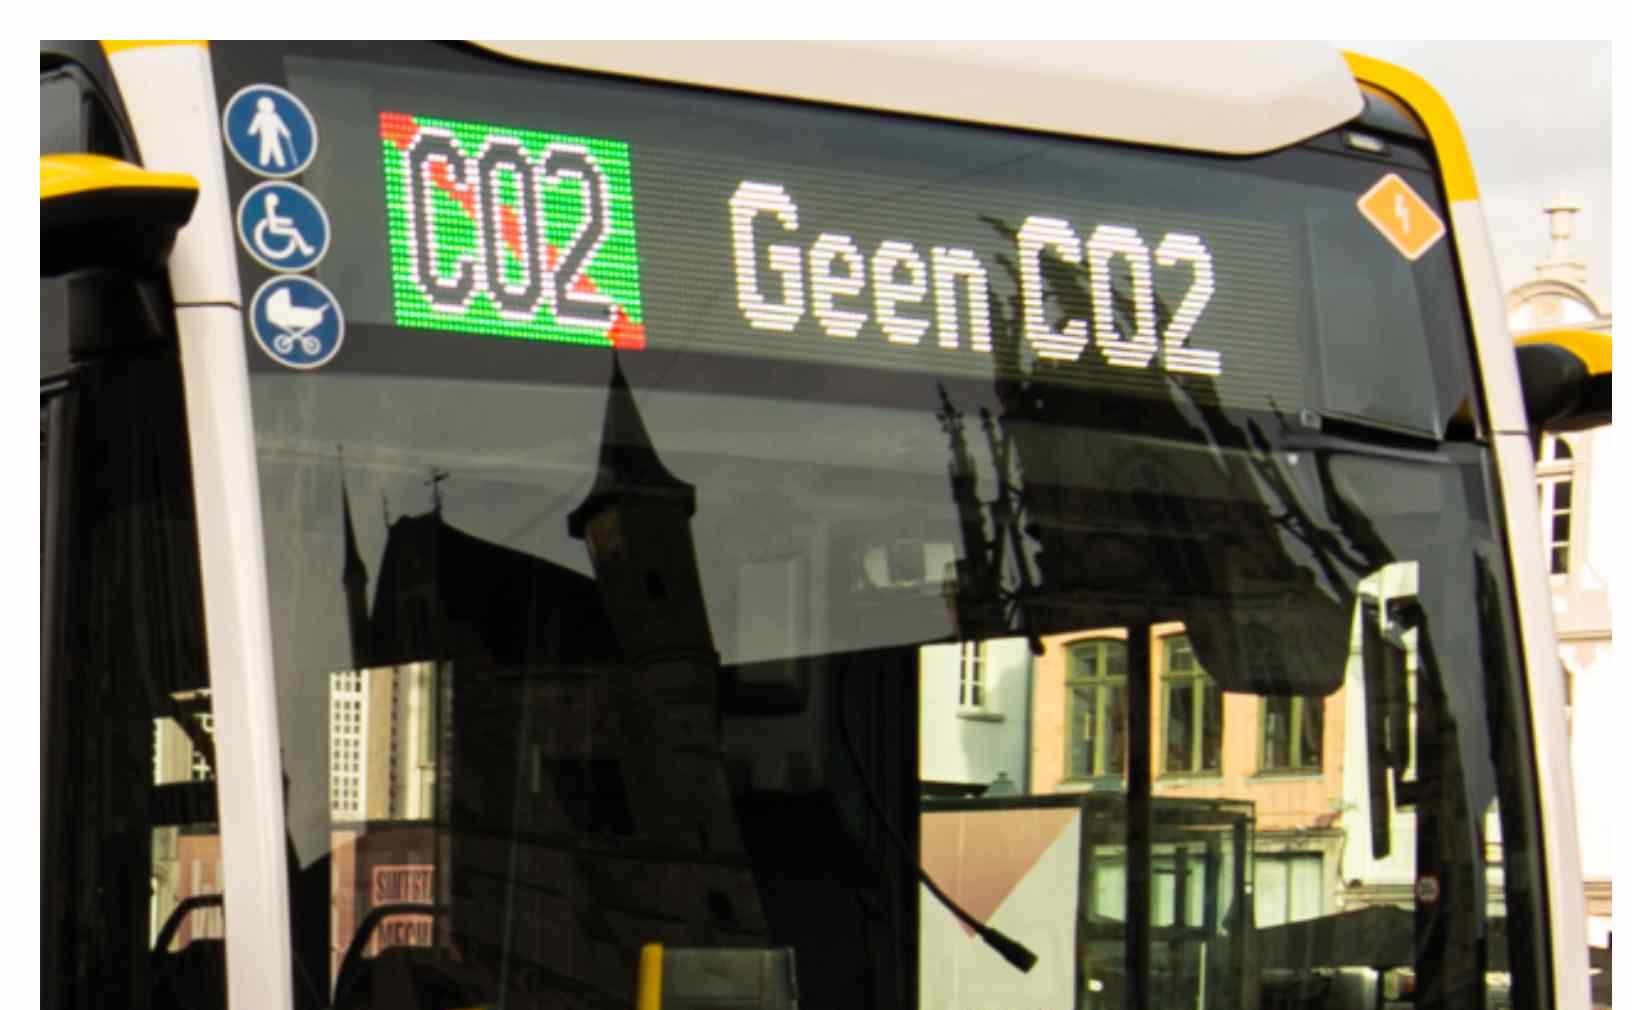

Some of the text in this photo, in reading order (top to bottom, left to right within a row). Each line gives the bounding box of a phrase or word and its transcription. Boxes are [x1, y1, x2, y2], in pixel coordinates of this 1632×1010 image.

[404, 127, 612, 328] CO2
[729, 181, 1222, 375] Geen CO2
